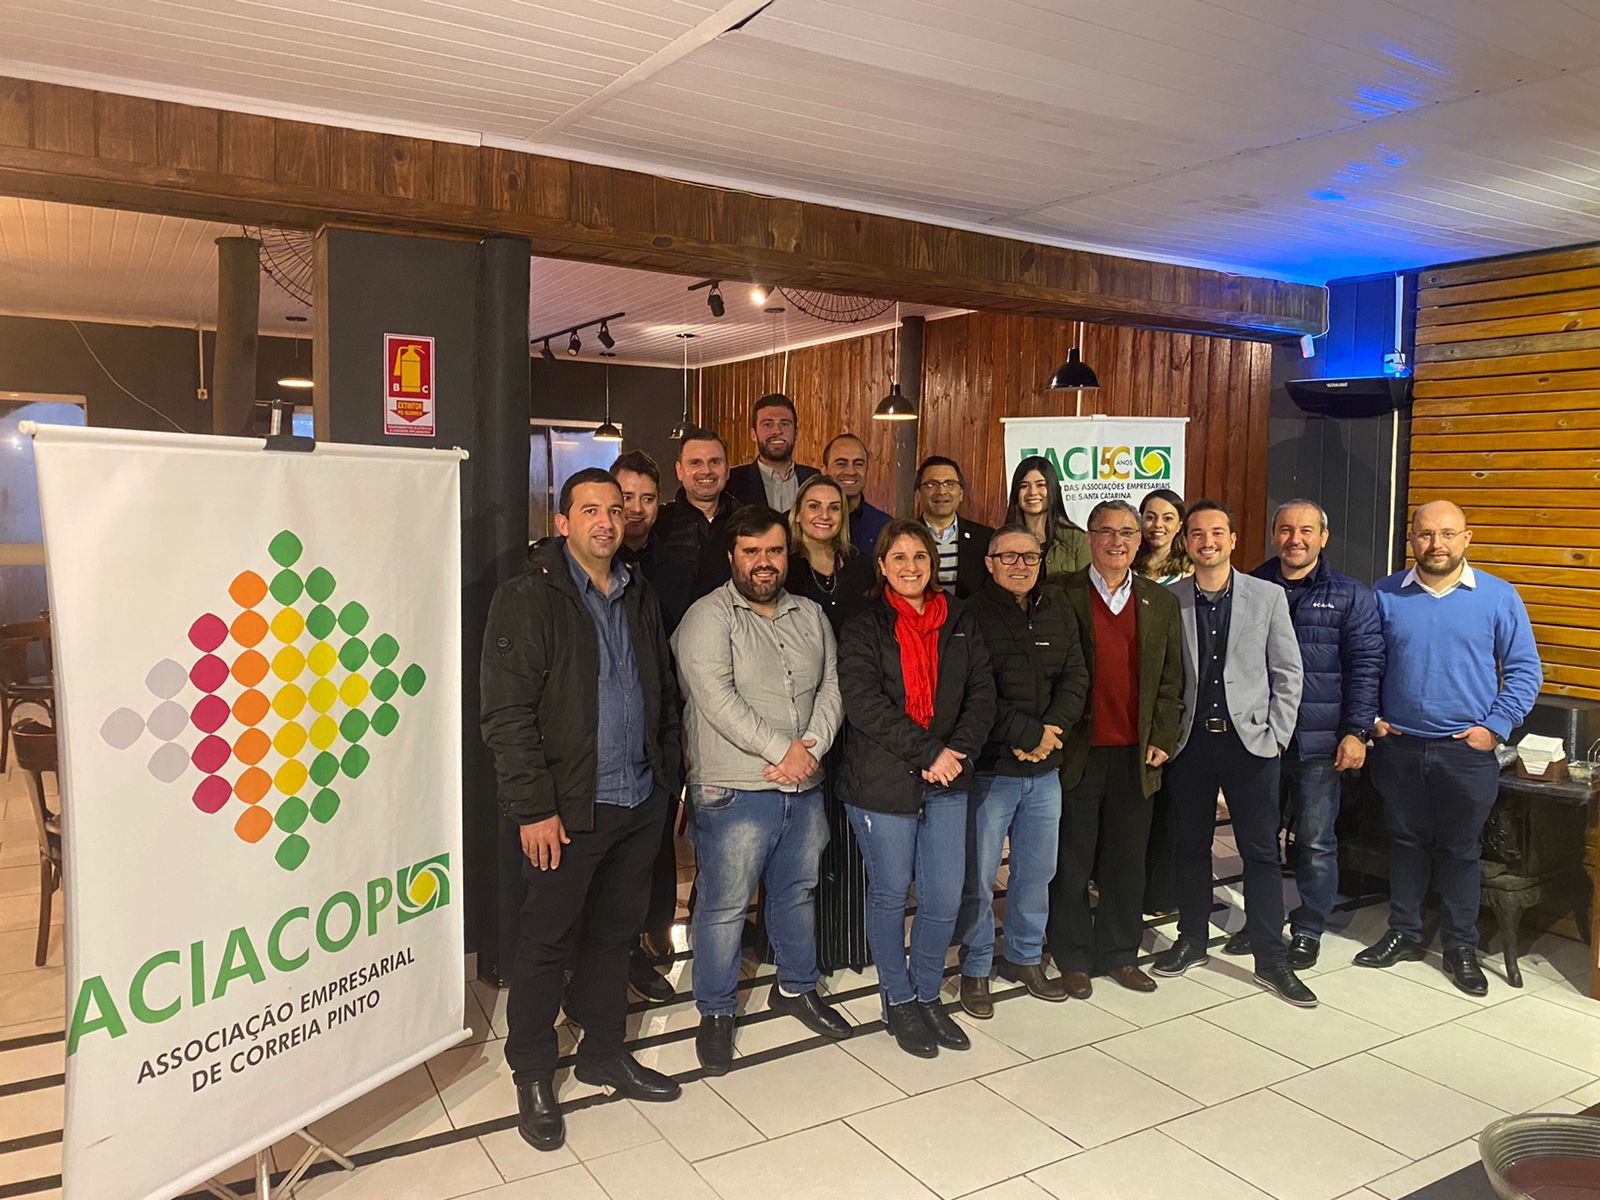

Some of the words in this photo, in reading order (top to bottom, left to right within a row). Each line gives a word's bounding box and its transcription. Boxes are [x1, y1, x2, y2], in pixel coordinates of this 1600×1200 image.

[393, 383, 400, 392] B
[422, 385, 429, 393] C
[1064, 483, 1080, 492] DAS
[1081, 481, 1125, 491] ASSOCIAÇÕES
[1126, 482, 1171, 490] EMPRESARIAIS
[1066, 493, 1077, 501] DE
[1078, 492, 1099, 501] SANTA
[1100, 492, 1132, 500] CATARINA
[67, 877, 393, 1057] ACIACOP
[137, 1002, 294, 1085] ASSOCIAÇÃO
[300, 947, 415, 1014] EMPRESARIAL
[192, 1062, 222, 1093] DE
[230, 1018, 322, 1074] CORREIA
[327, 989, 380, 1030] PINTO
